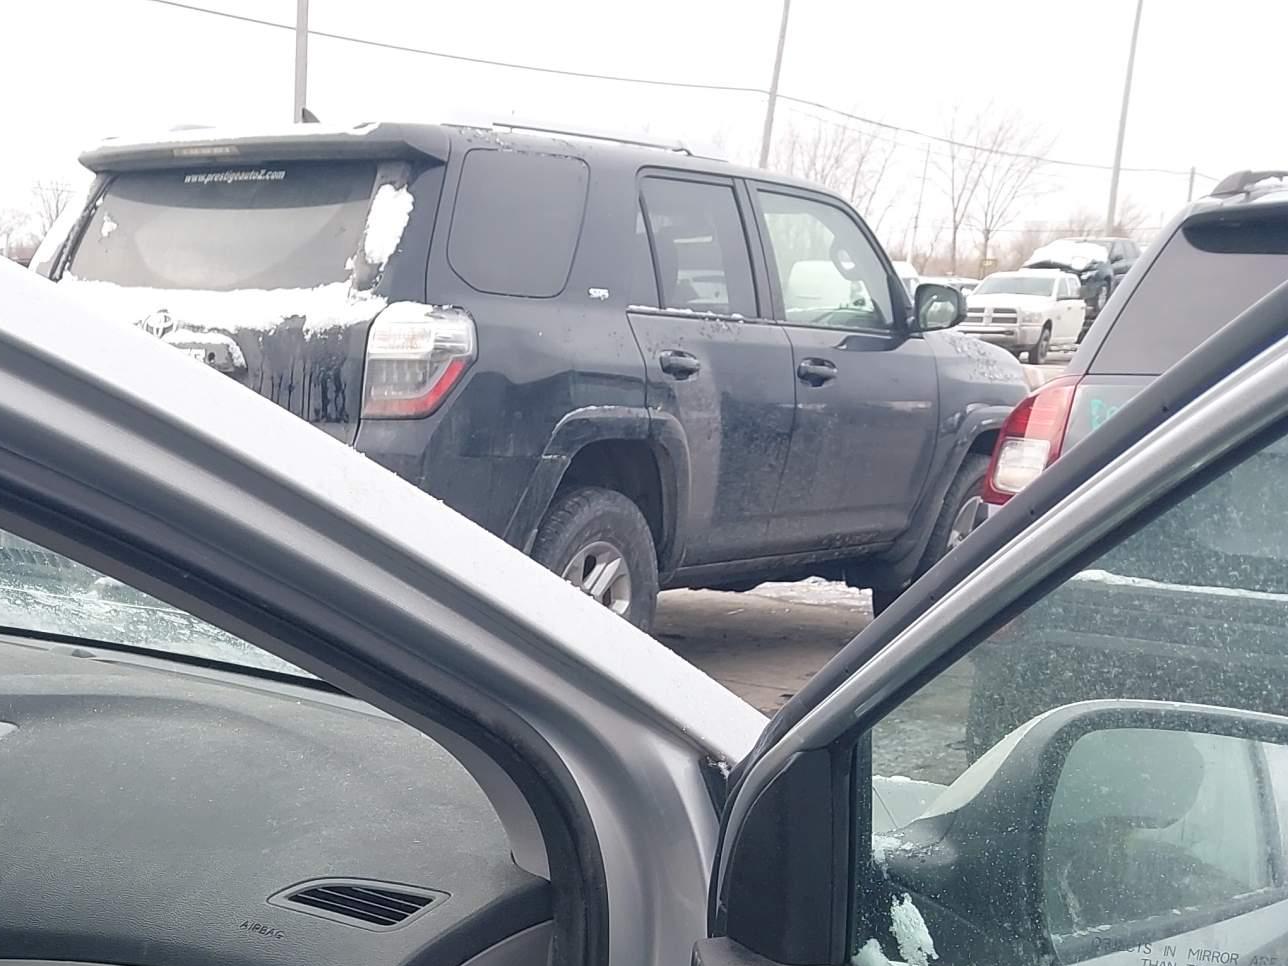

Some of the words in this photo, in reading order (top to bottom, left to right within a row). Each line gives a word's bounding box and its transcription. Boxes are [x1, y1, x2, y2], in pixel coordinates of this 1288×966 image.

[239, 920, 285, 939] AIRBAG
[1163, 945, 1177, 958] IN
[1187, 948, 1240, 965] MIRROR
